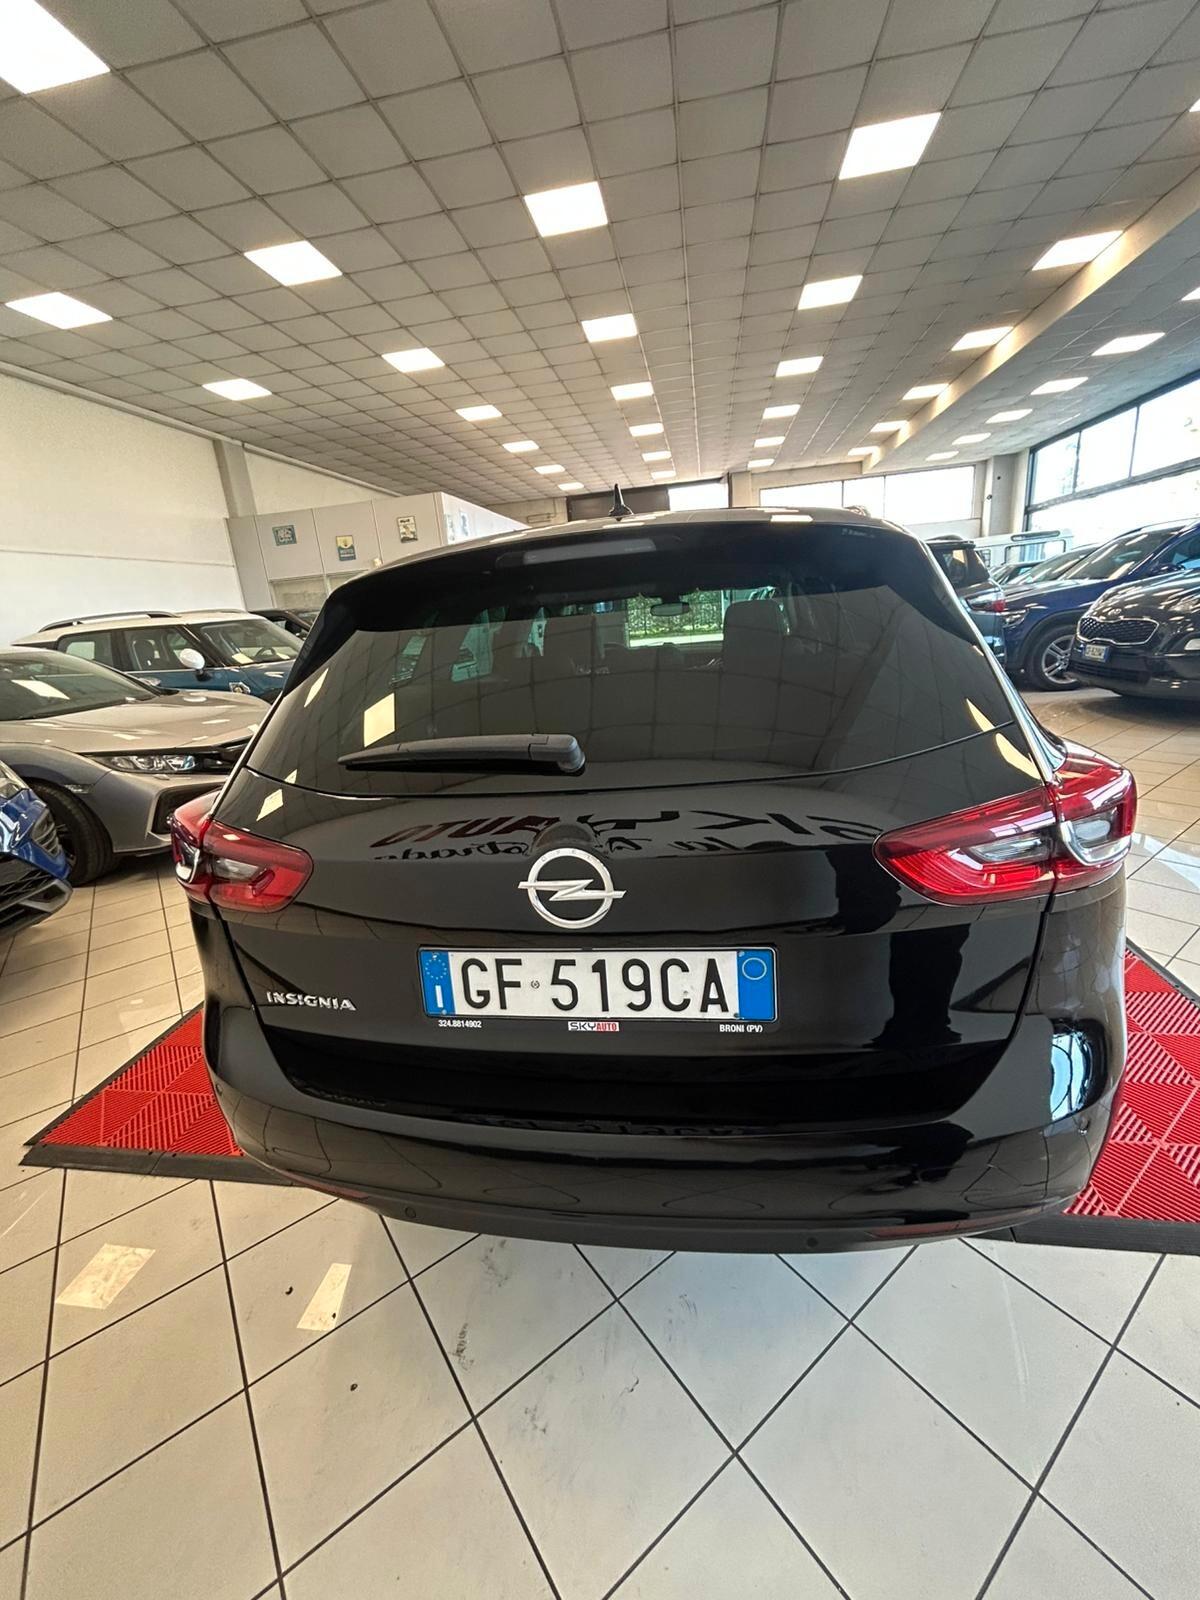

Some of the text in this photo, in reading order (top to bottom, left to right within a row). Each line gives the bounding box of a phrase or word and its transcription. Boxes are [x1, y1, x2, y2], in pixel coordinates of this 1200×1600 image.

[266, 991, 356, 1011] INSIGNIA
[719, 1023, 764, 1033] BRONI (PV)
